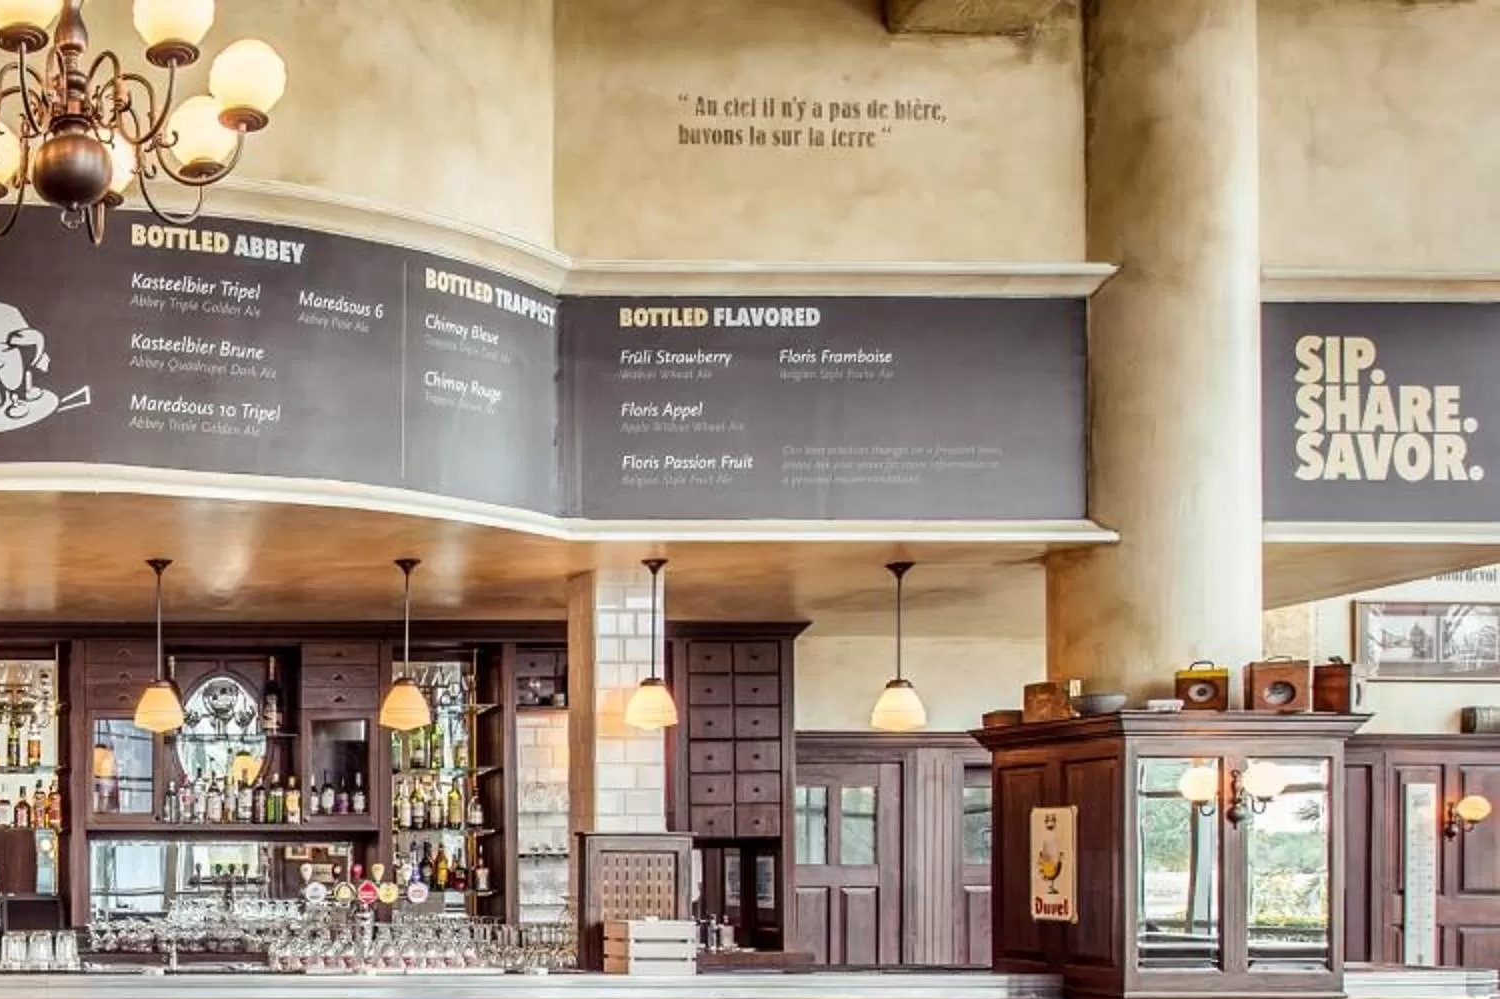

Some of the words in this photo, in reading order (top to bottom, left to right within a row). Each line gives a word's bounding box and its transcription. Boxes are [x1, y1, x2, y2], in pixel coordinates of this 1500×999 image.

[724, 96, 756, 118] ciel
[763, 96, 775, 118] il
[829, 100, 861, 123] pas
[867, 99, 888, 120] de
[678, 123, 743, 145] buvons
[750, 125, 766, 146] la
[772, 126, 802, 147] sur
[808, 126, 824, 147] la
[131, 223, 230, 254] BOTTLED
[233, 234, 306, 265] ABBEY
[131, 272, 217, 296] Kasteelbier
[220, 280, 262, 303] Tripel
[425, 267, 493, 304] BOTTLED
[494, 287, 556, 328] TRAPPIST
[299, 290, 371, 317] Maredsous
[374, 303, 384, 320] 6
[619, 307, 709, 328] BOTTLED
[713, 307, 821, 328] FLAVORED
[130, 332, 217, 356] Kasteelbier
[219, 340, 266, 361] Brune
[656, 348, 733, 368] Strawberry
[779, 347, 817, 364] Floris
[820, 345, 893, 364] Framboise
[1294, 335, 1386, 384] SIP.
[424, 370, 469, 397] Chimay
[128, 393, 215, 417] Maredsous
[218, 403, 238, 418] 10
[240, 402, 282, 425] Tripel
[621, 400, 660, 418] Floris
[661, 400, 704, 421] Appel
[1294, 383, 1479, 433] SHARE.
[622, 454, 660, 470] Floris
[663, 453, 717, 470] Passion
[720, 453, 754, 470] Fruit
[1294, 432, 1485, 482] SAVOR.
[1034, 895, 1070, 916] Duvel
